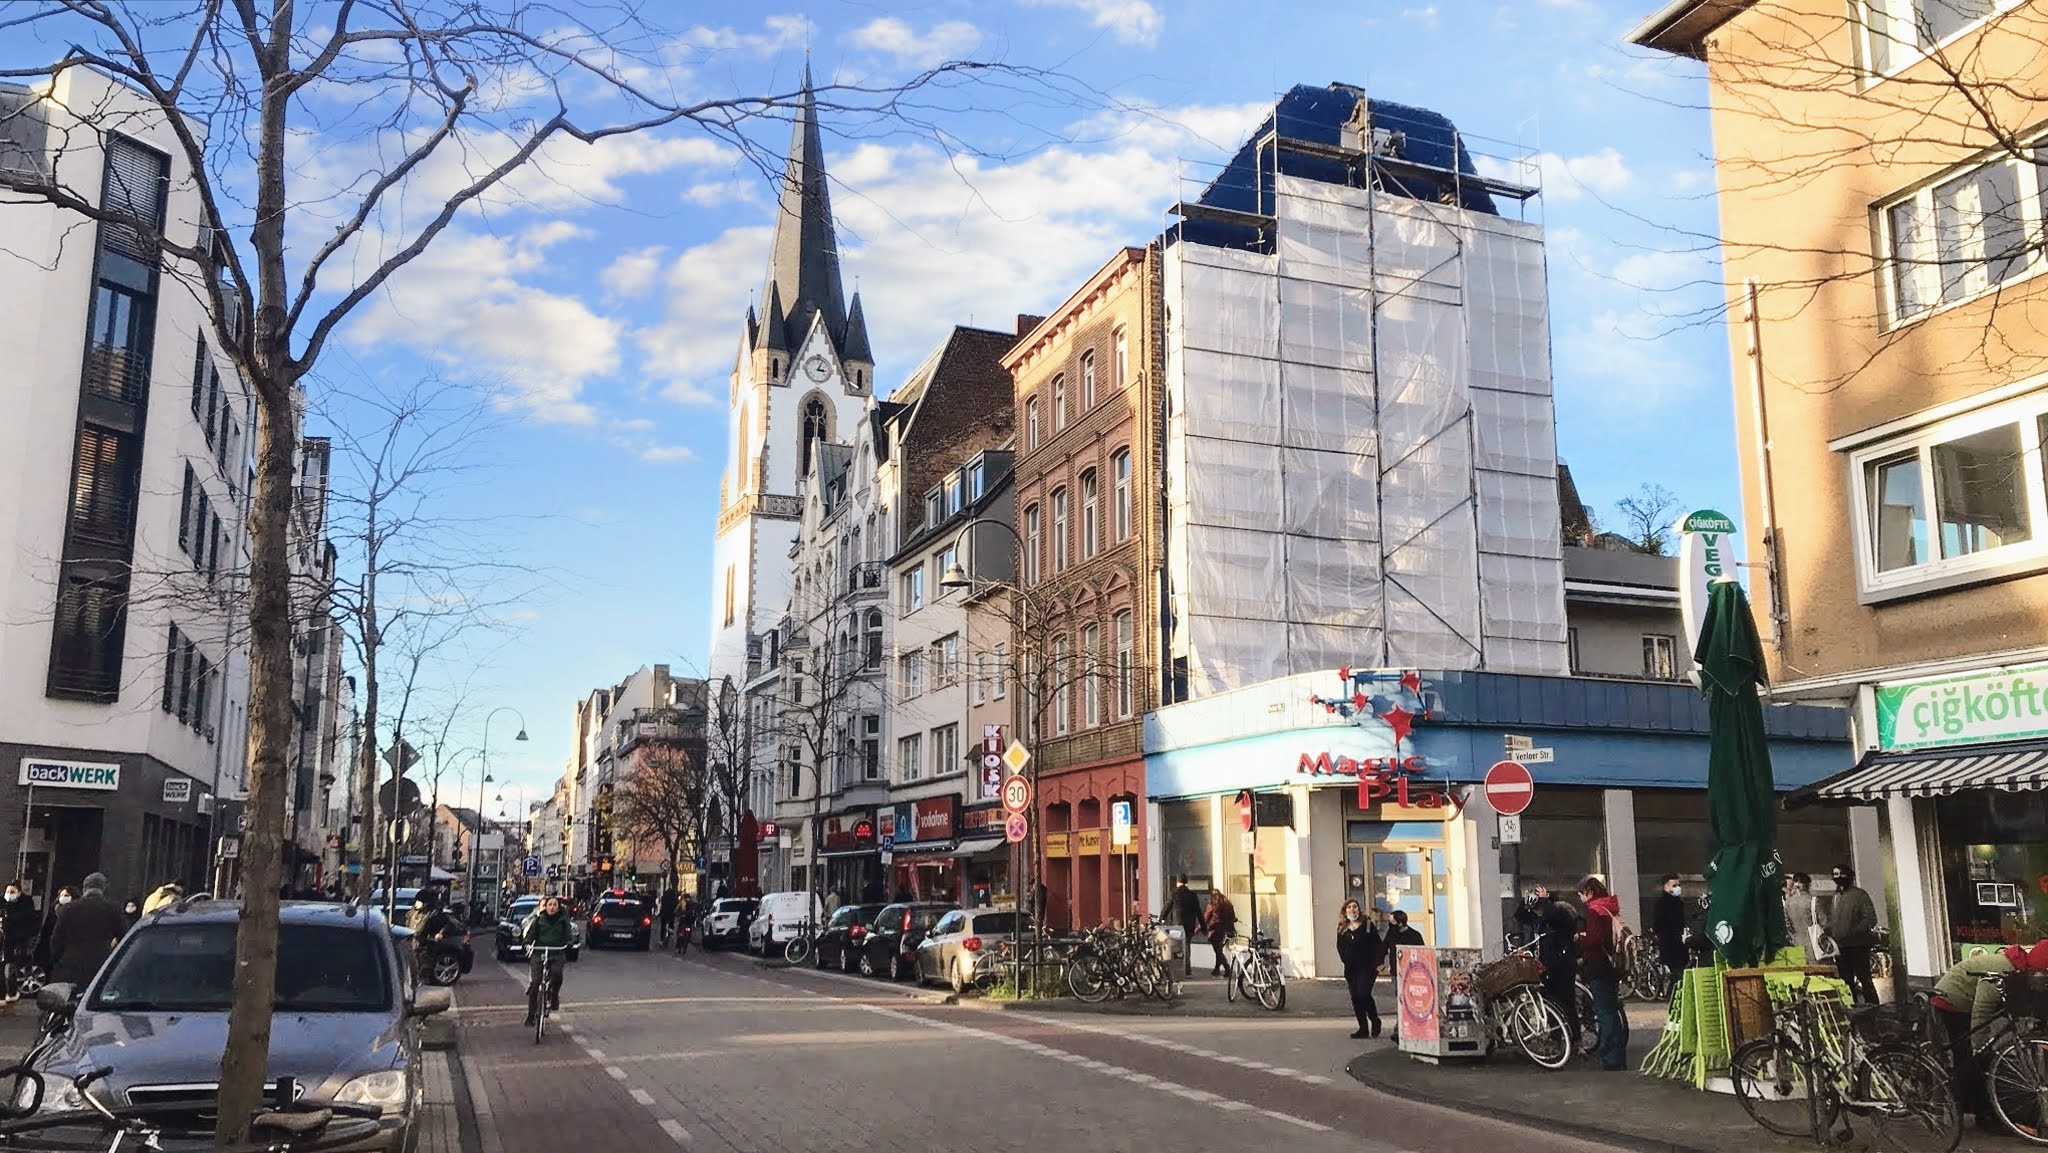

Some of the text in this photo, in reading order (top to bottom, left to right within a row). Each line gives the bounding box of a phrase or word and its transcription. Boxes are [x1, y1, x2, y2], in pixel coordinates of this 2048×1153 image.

[983, 725, 1002, 797] KIOSK
[1297, 752, 1426, 784] Magic
[29, 764, 117, 785] back WERK
[1008, 786, 1025, 803] 30
[1359, 774, 1470, 821] Play
[921, 809, 949, 829] vodafone
[765, 824, 775, 835] T
[884, 837, 891, 849] P
[526, 860, 534, 871] P
